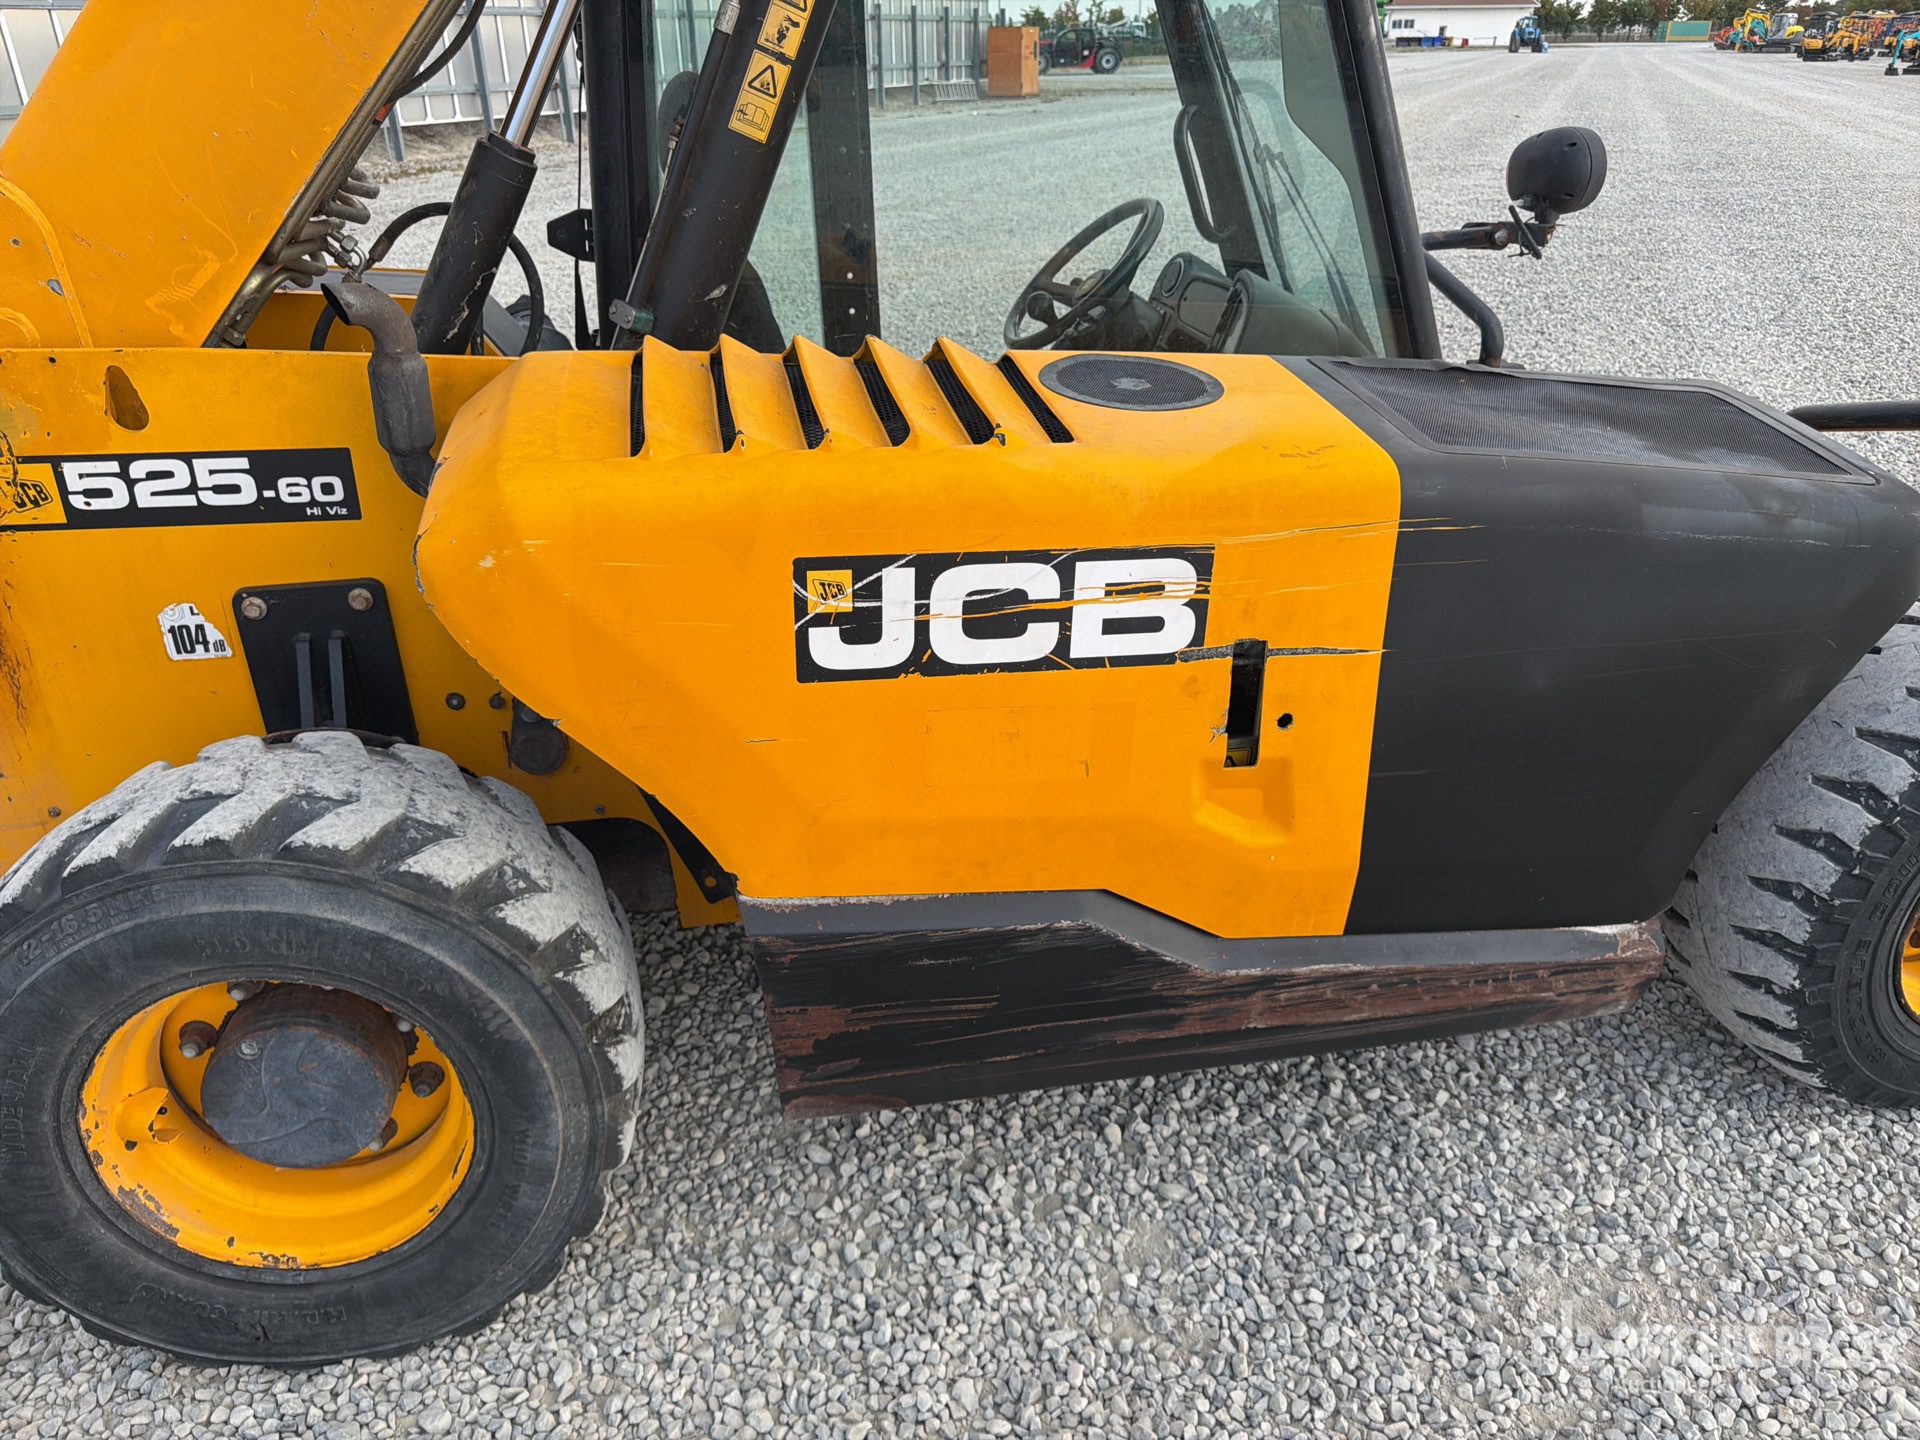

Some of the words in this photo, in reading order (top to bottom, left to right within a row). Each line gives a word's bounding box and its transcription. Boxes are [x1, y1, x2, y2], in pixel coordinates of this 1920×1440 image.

[306, 506, 322, 516] Hi
[325, 505, 348, 515] Viz
[819, 580, 846, 601] JCB
[808, 558, 1198, 670] JCB
[167, 623, 210, 655] 104
[213, 639, 226, 653] dB
